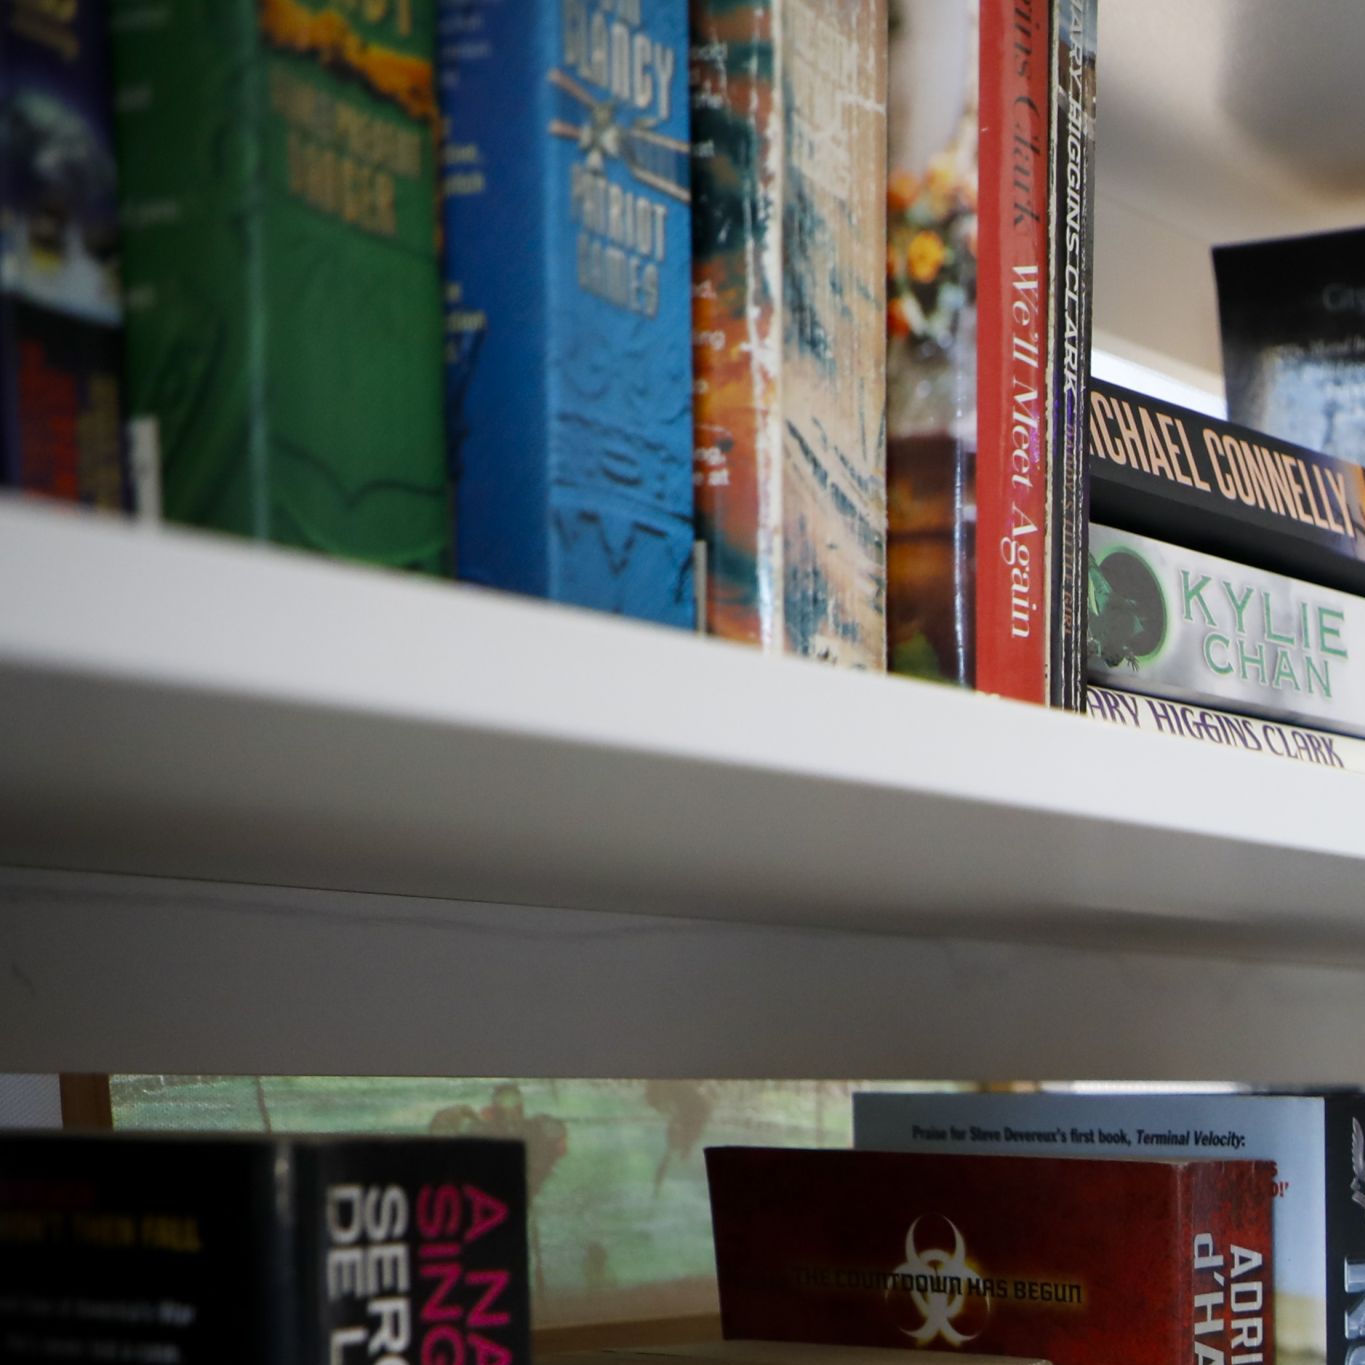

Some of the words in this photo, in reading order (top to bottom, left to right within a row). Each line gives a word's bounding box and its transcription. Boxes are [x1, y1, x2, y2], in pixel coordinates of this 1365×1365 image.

[569, 160, 668, 263] PATRIOT
[1012, 95, 1041, 226] Clark
[1064, 101, 1083, 253] HIGGINS
[1012, 264, 1040, 368] We'll
[1062, 264, 1081, 402] CLARK
[1011, 379, 1039, 492] Meet
[1089, 390, 1213, 493] ICHAEL
[1202, 427, 1357, 538] CONNELLY
[1000, 504, 1039, 639] Again
[1178, 569, 1349, 659] KYLIE
[1203, 634, 1334, 698] CHAN
[1086, 687, 1142, 728] ARY
[1151, 698, 1263, 753] HIGGINS
[1261, 724, 1345, 769] CLARK
[911, 1124, 948, 1140] Praise
[949, 1125, 967, 1140] for
[970, 1126, 1001, 1141] Steve
[1003, 1126, 1068, 1144] Devereux's
[1070, 1128, 1095, 1143] first
[1098, 1128, 1132, 1147] book,
[1136, 1129, 1190, 1147] Terminal
[1193, 1130, 1246, 1150] Velocity:
[326, 1183, 363, 1301] DE
[464, 1183, 509, 1243] A
[834, 1268, 963, 1297] COUNTDOWN
[967, 1276, 1008, 1300] HAS
[1013, 1280, 1083, 1304] BEGUN
